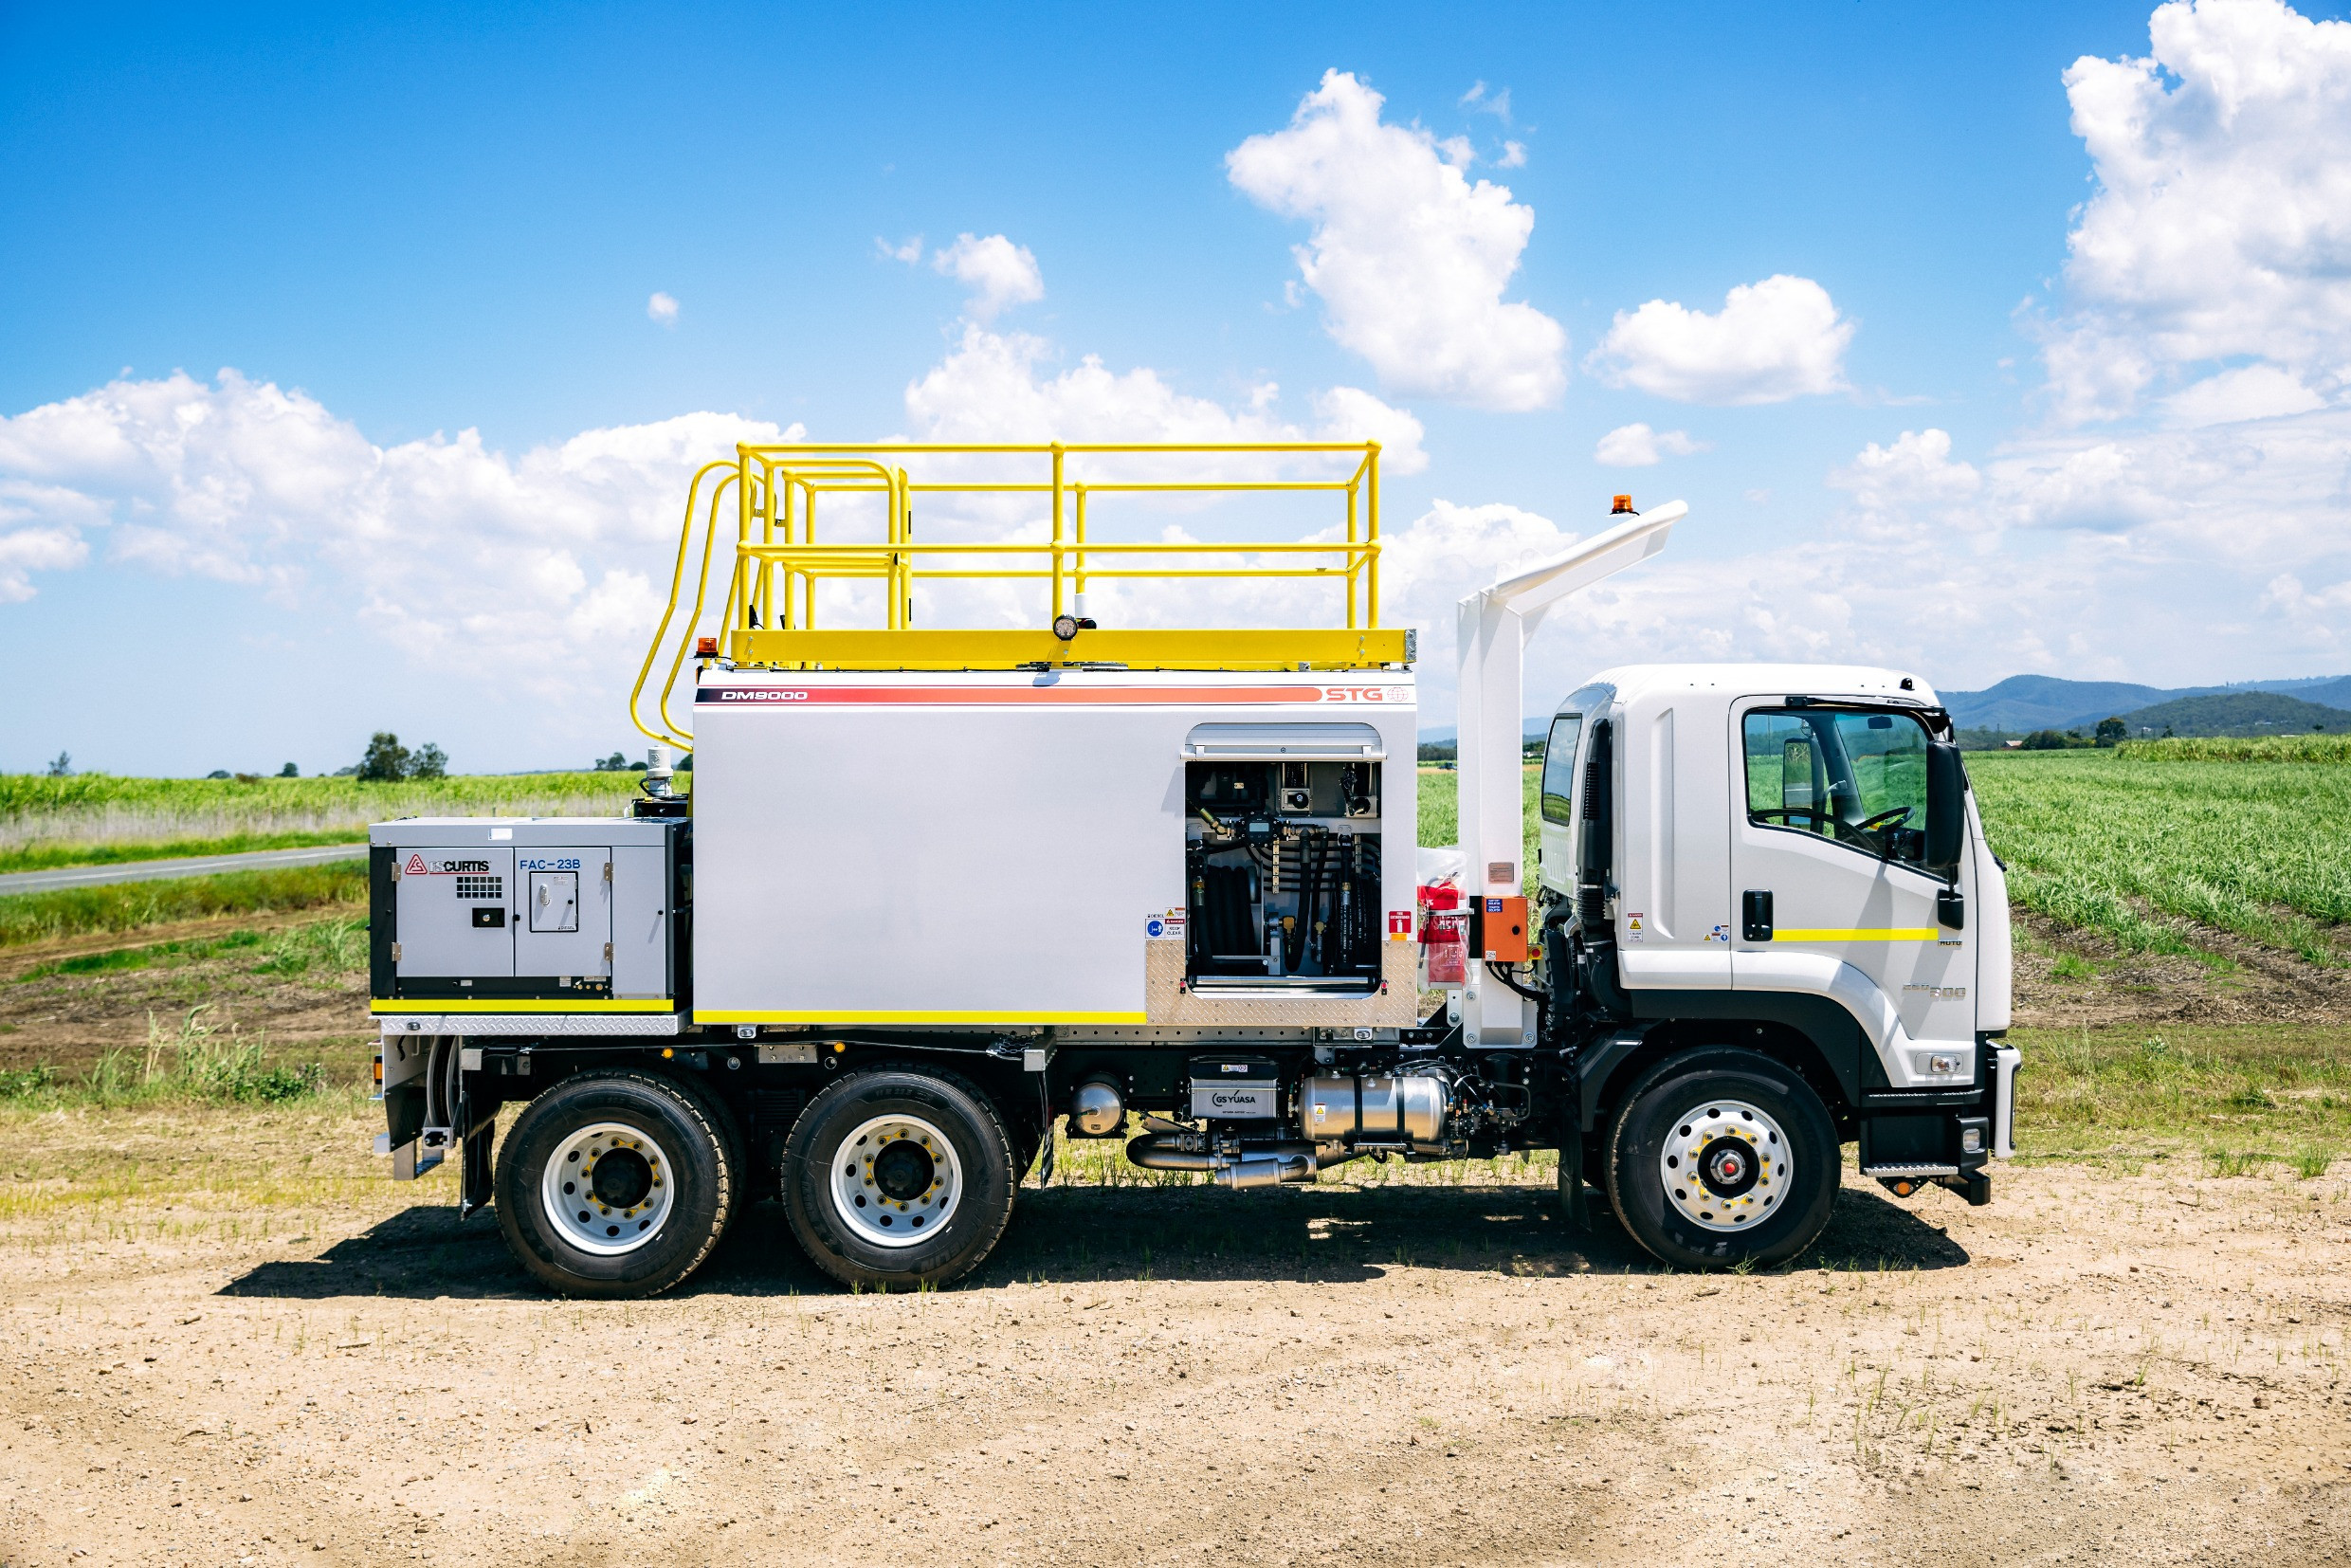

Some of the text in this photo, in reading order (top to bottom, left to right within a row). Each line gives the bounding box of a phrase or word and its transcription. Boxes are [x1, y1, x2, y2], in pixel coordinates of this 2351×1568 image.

[721, 691, 808, 701] DM9000
[1326, 687, 1383, 702] STG
[519, 859, 581, 870] FAC-23B
[1228, 1090, 1256, 1103] YUASA
